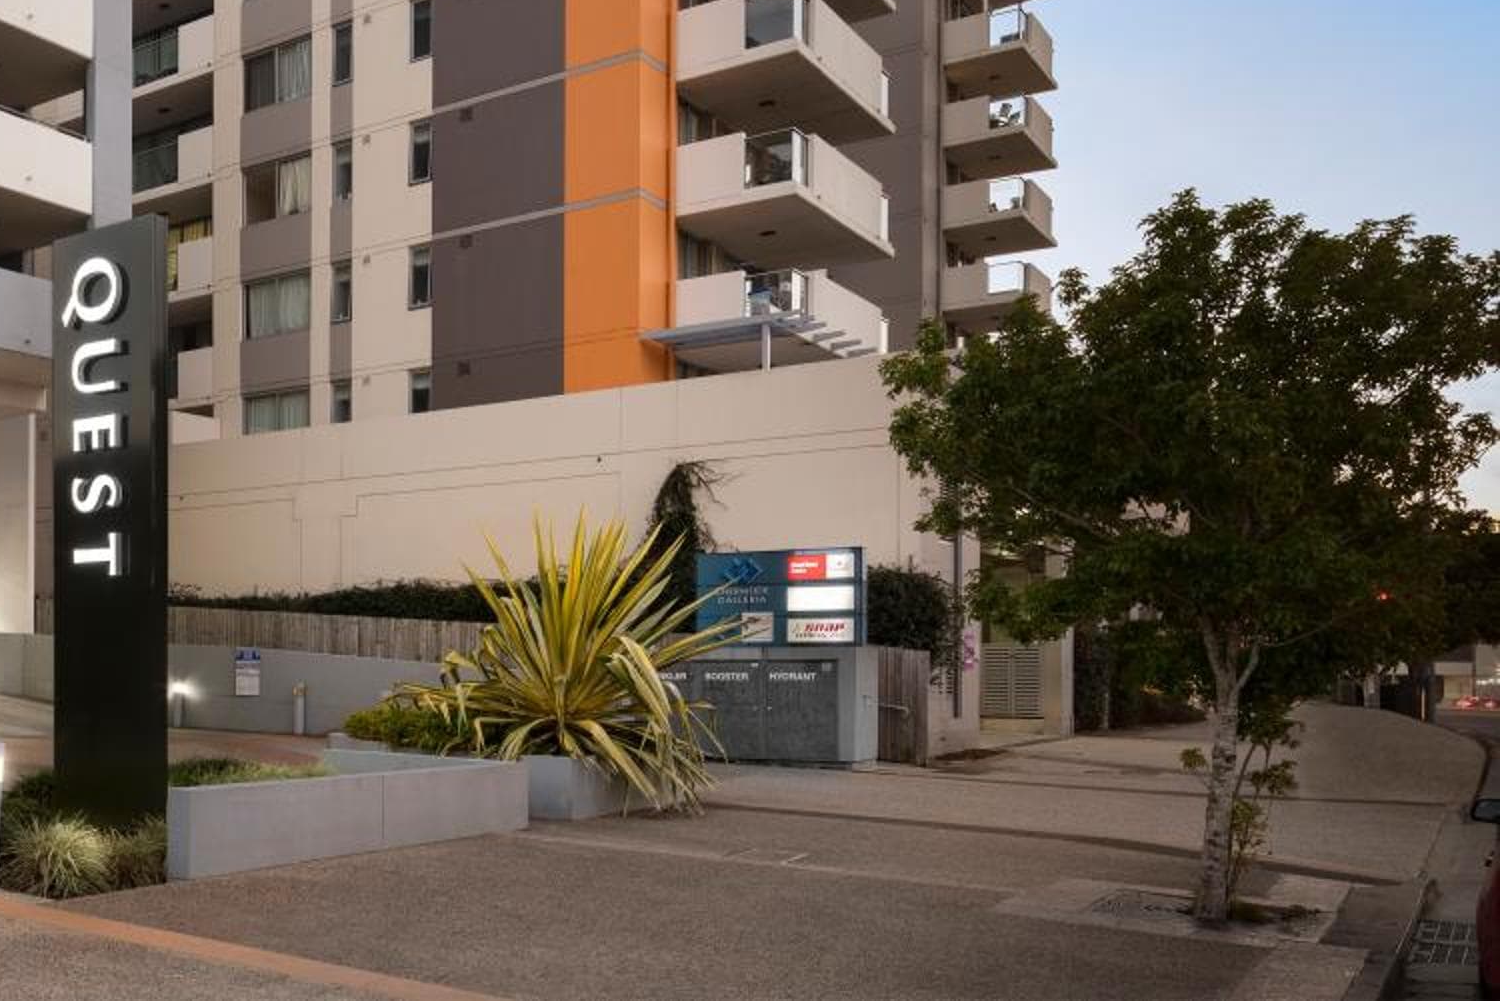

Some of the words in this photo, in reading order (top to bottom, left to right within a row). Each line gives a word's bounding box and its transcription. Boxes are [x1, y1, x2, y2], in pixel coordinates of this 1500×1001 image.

[61, 257, 121, 576] QUEST
[704, 671, 749, 681] BOOSTER
[769, 671, 817, 681] HYDRANT
